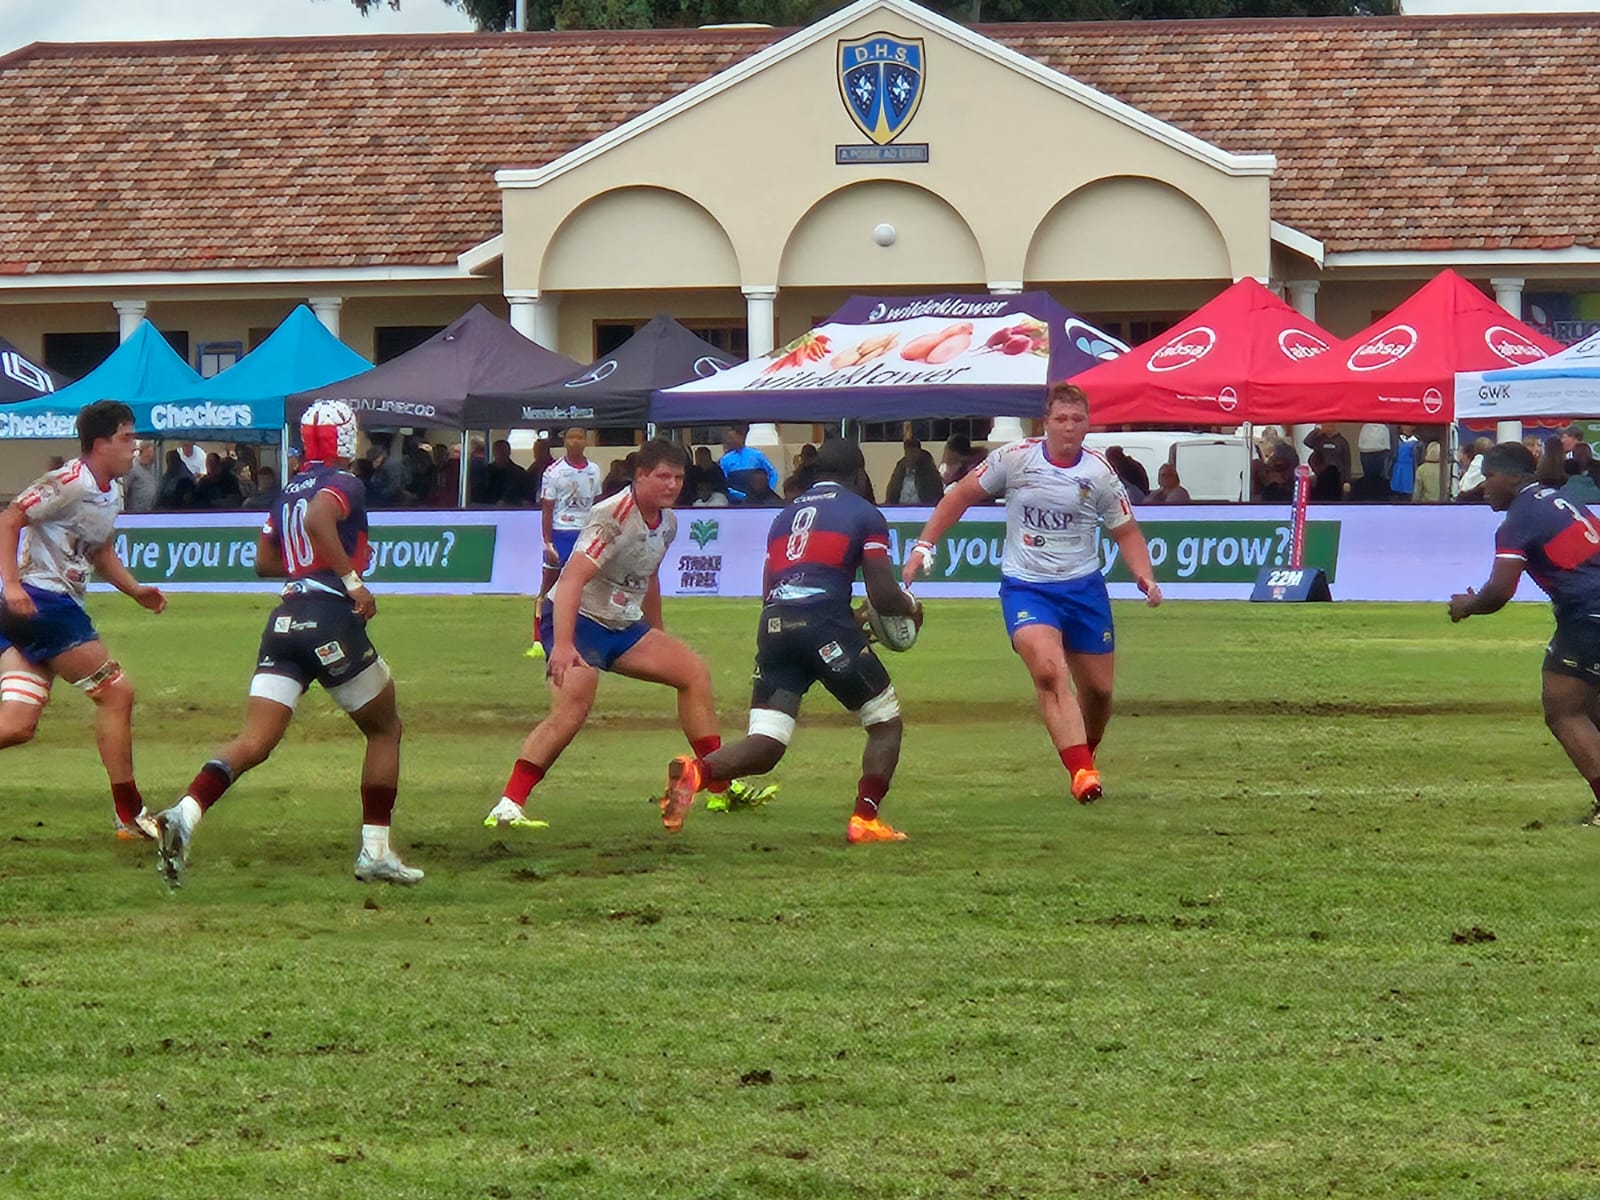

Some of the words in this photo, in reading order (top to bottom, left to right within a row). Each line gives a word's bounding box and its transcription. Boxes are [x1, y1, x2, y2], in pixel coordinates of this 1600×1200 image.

[1478, 385, 1511, 399] GWK
[0, 412, 79, 436] Checker
[151, 401, 252, 430] Checkers
[786, 506, 817, 561] 8
[1022, 505, 1074, 530] KKSP
[282, 498, 314, 573] 10
[1176, 526, 1290, 577] grow?
[115, 534, 159, 568] Are
[165, 542, 221, 577] you
[945, 537, 1008, 577] you
[1266, 570, 1304, 587] 22M
